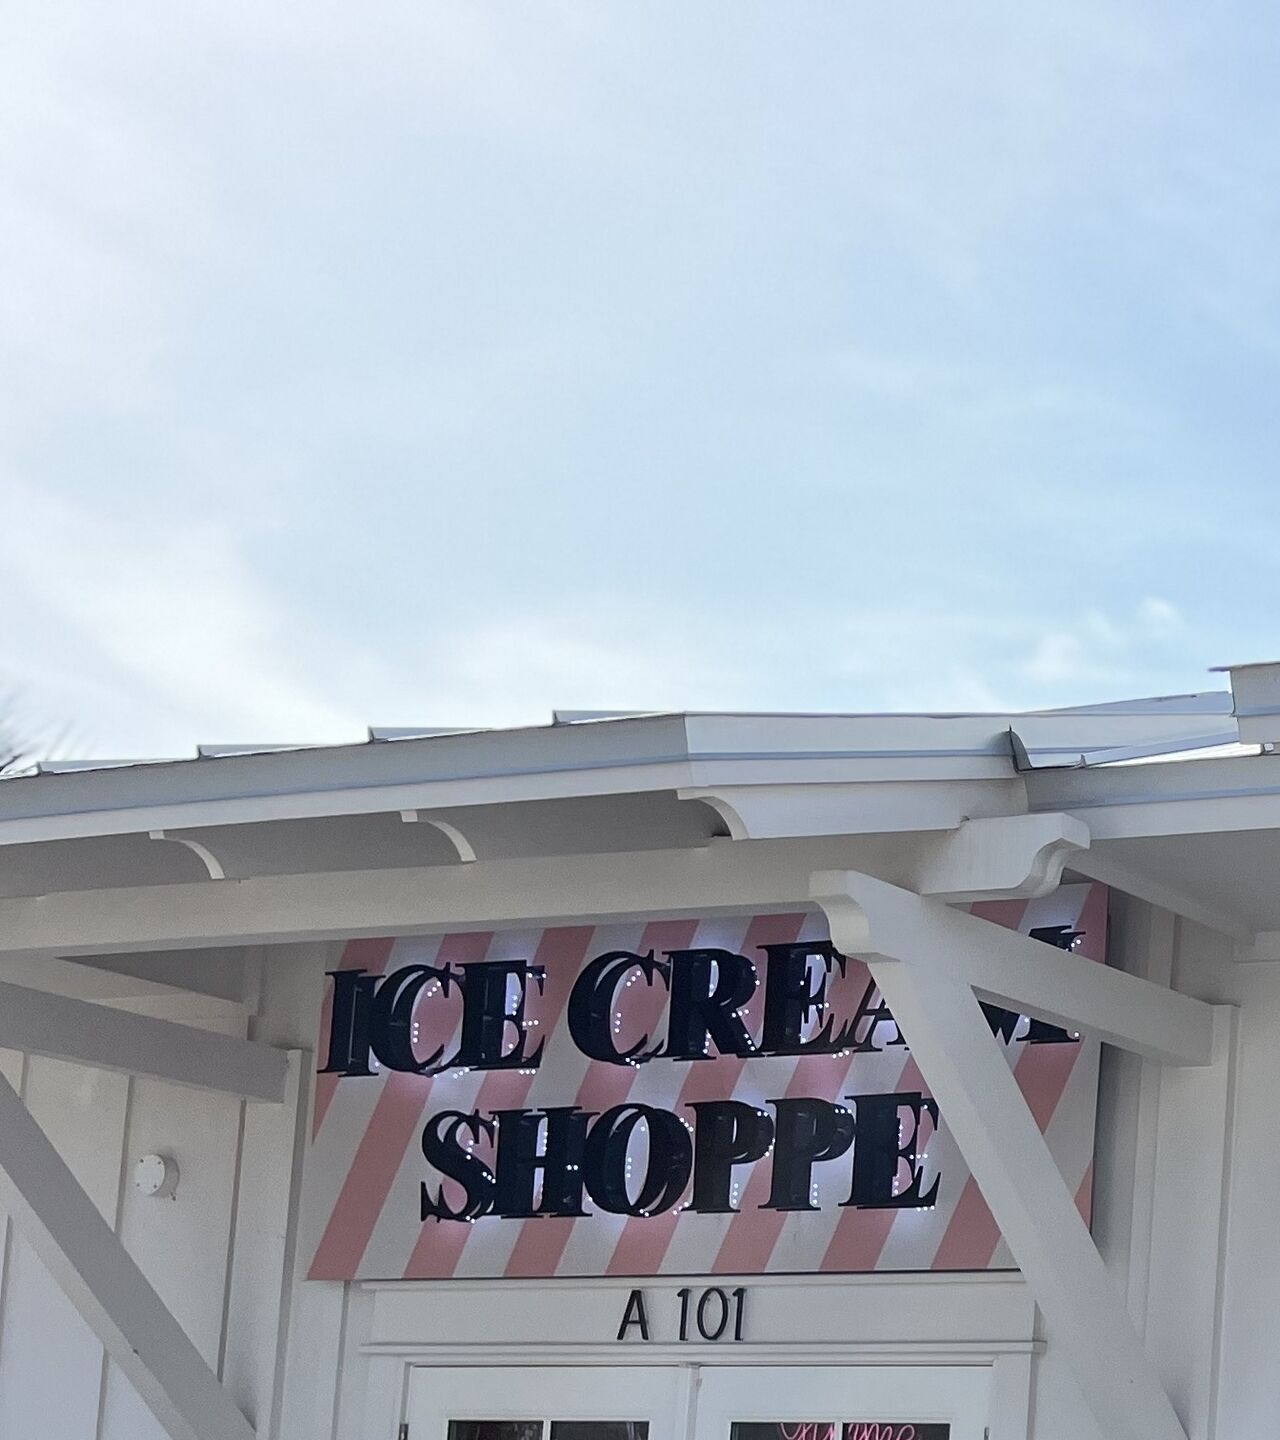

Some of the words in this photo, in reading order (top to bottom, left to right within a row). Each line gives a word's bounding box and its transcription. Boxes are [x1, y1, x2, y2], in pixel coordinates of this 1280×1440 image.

[316, 958, 546, 1078] ICE
[420, 1091, 942, 1224] SHOPPE
[616, 1289, 650, 1341] A
[676, 1286, 748, 1342] 101
